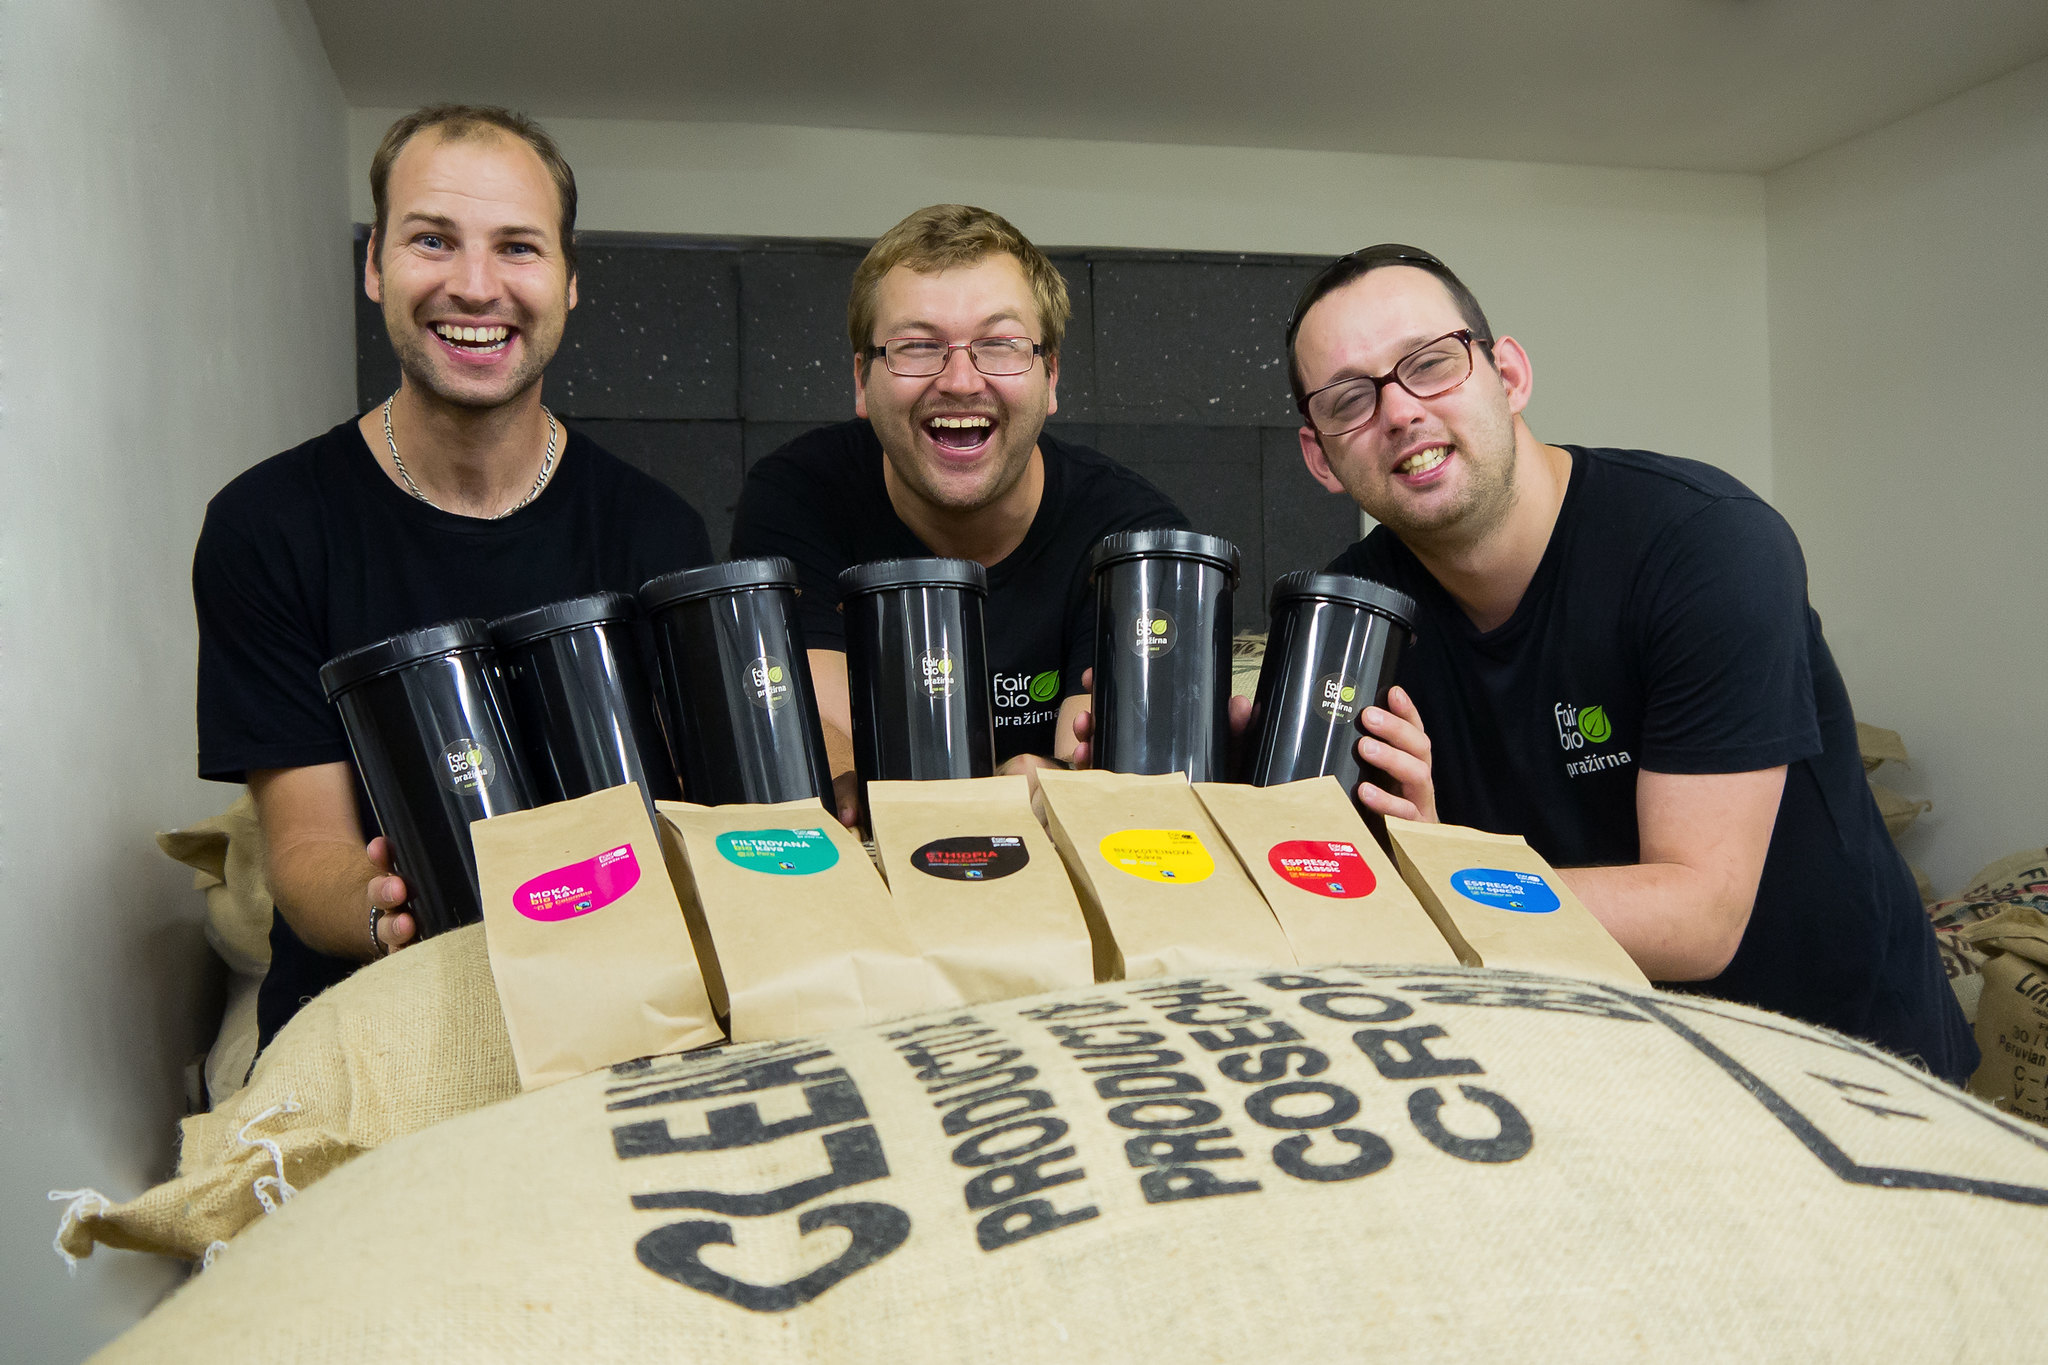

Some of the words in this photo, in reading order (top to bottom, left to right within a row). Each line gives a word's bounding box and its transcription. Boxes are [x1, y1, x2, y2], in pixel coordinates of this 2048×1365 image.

[994, 673, 1031, 692] fair
[995, 691, 1030, 708] bio
[1554, 702, 1577, 727] fair
[1560, 728, 1584, 751] bio
[1566, 751, 1632, 779] pražírna
[925, 850, 998, 859] ETHIOPIA
[1280, 858, 1340, 867] ESPRESSO
[1303, 864, 1341, 873] classic
[529, 885, 570, 900] MOKA
[1463, 879, 1524, 891] ESPRESSO
[530, 897, 552, 906] bio
[1255, 973, 1536, 1165] CROP
